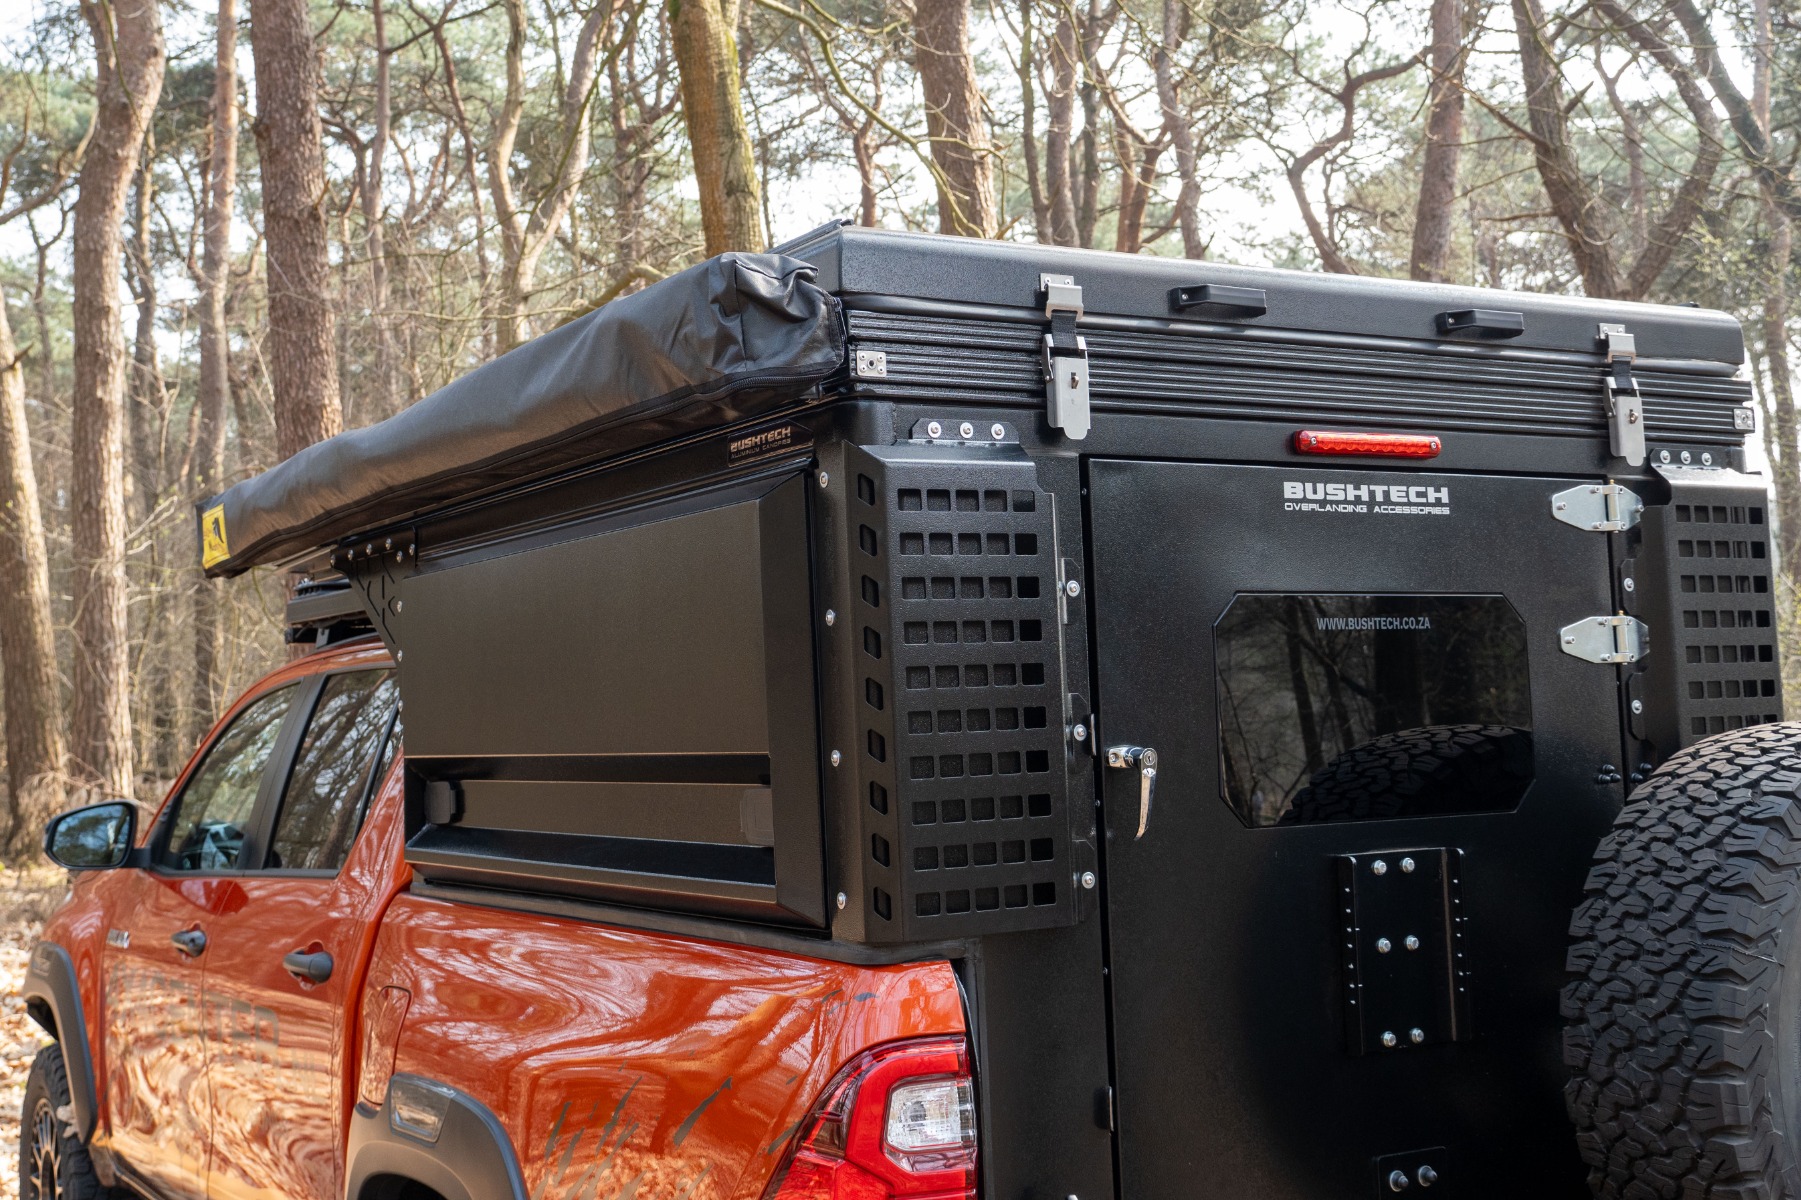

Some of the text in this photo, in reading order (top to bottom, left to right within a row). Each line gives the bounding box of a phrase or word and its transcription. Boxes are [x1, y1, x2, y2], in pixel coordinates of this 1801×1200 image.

[730, 426, 791, 452] BUSHTECH
[1283, 481, 1449, 503] BUSHTECH
[1284, 502, 1450, 515] OVERLANDING ACCESSORIES
[1316, 617, 1431, 630] WWW.BUSHTECH.CO.ZA
